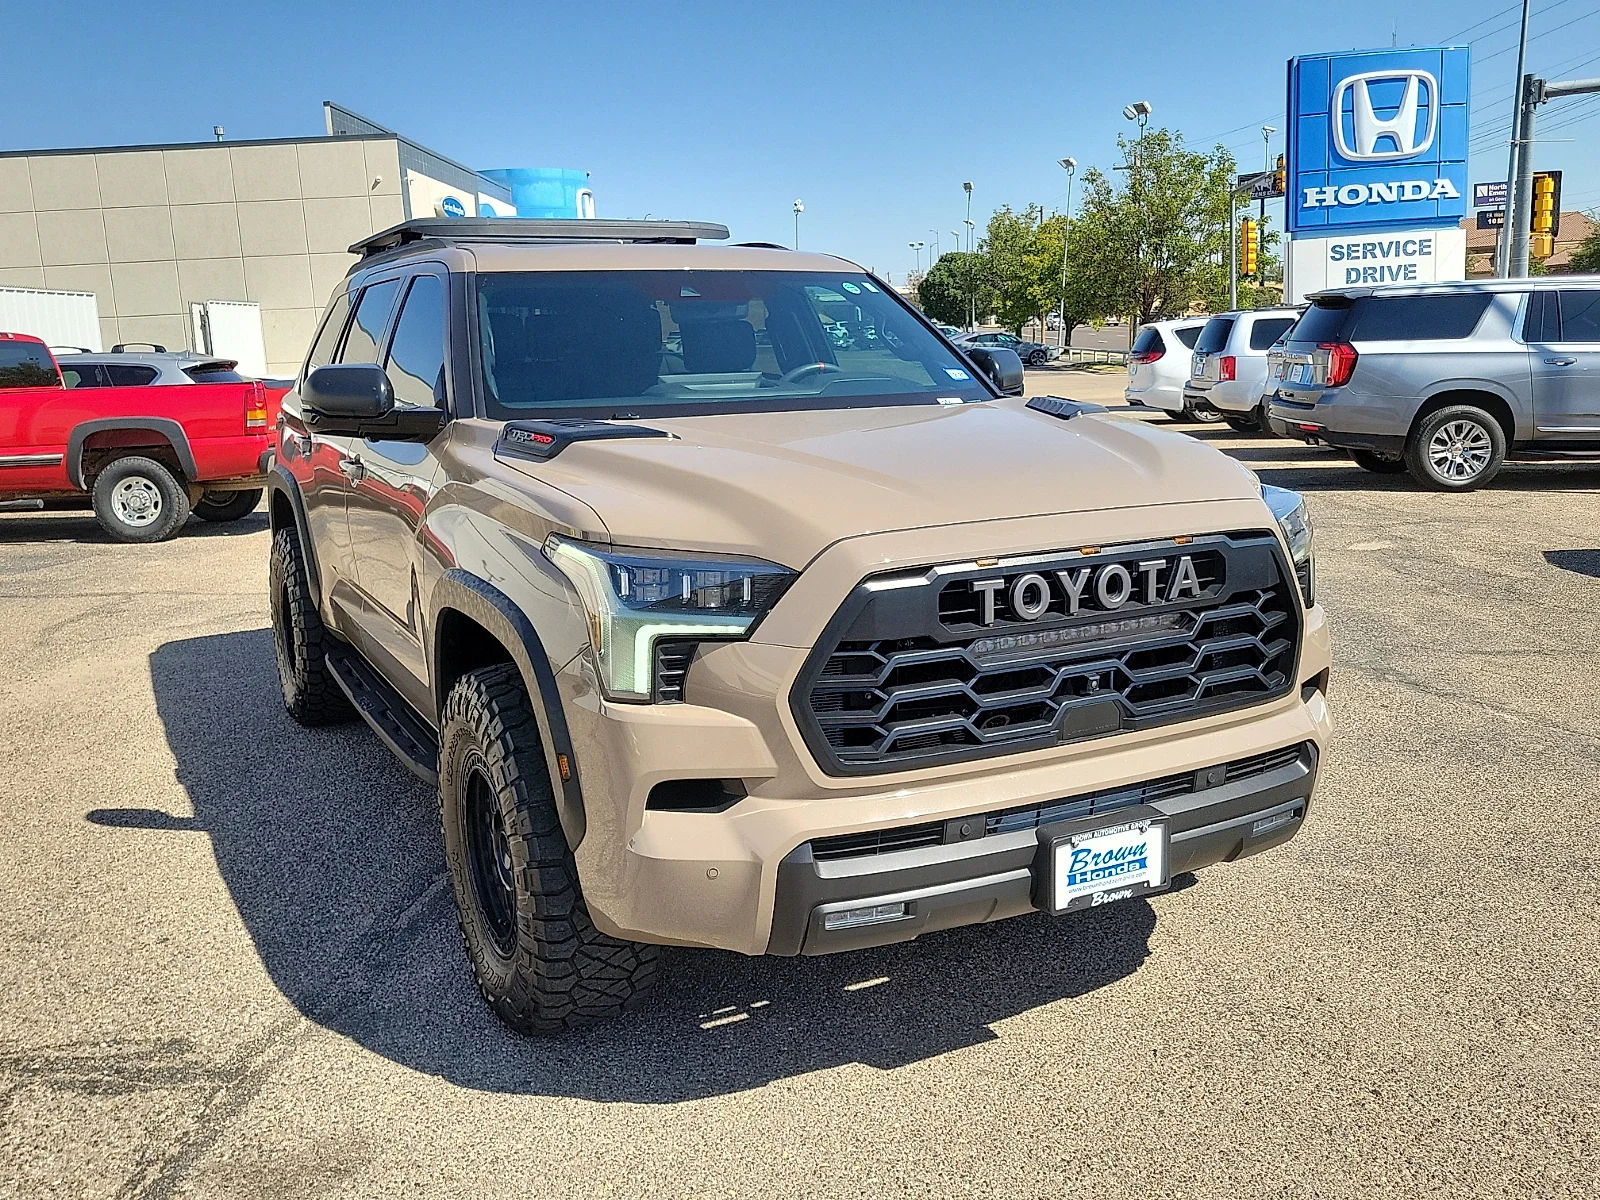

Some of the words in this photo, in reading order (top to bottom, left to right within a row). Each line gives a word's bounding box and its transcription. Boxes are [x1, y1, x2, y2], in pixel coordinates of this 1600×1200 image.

[1303, 178, 1461, 208] HONDA
[1330, 238, 1432, 261] SERVICE
[1345, 263, 1417, 285] DRIVE
[972, 556, 1201, 626] TOYOTA
[1071, 832, 1093, 844] BROWN
[1093, 823, 1130, 838] AUTOMOTIVE
[1130, 820, 1152, 831] GROUP
[1068, 842, 1148, 873] Brown
[1075, 861, 1141, 884] Honda
[1091, 888, 1134, 907] Brown
